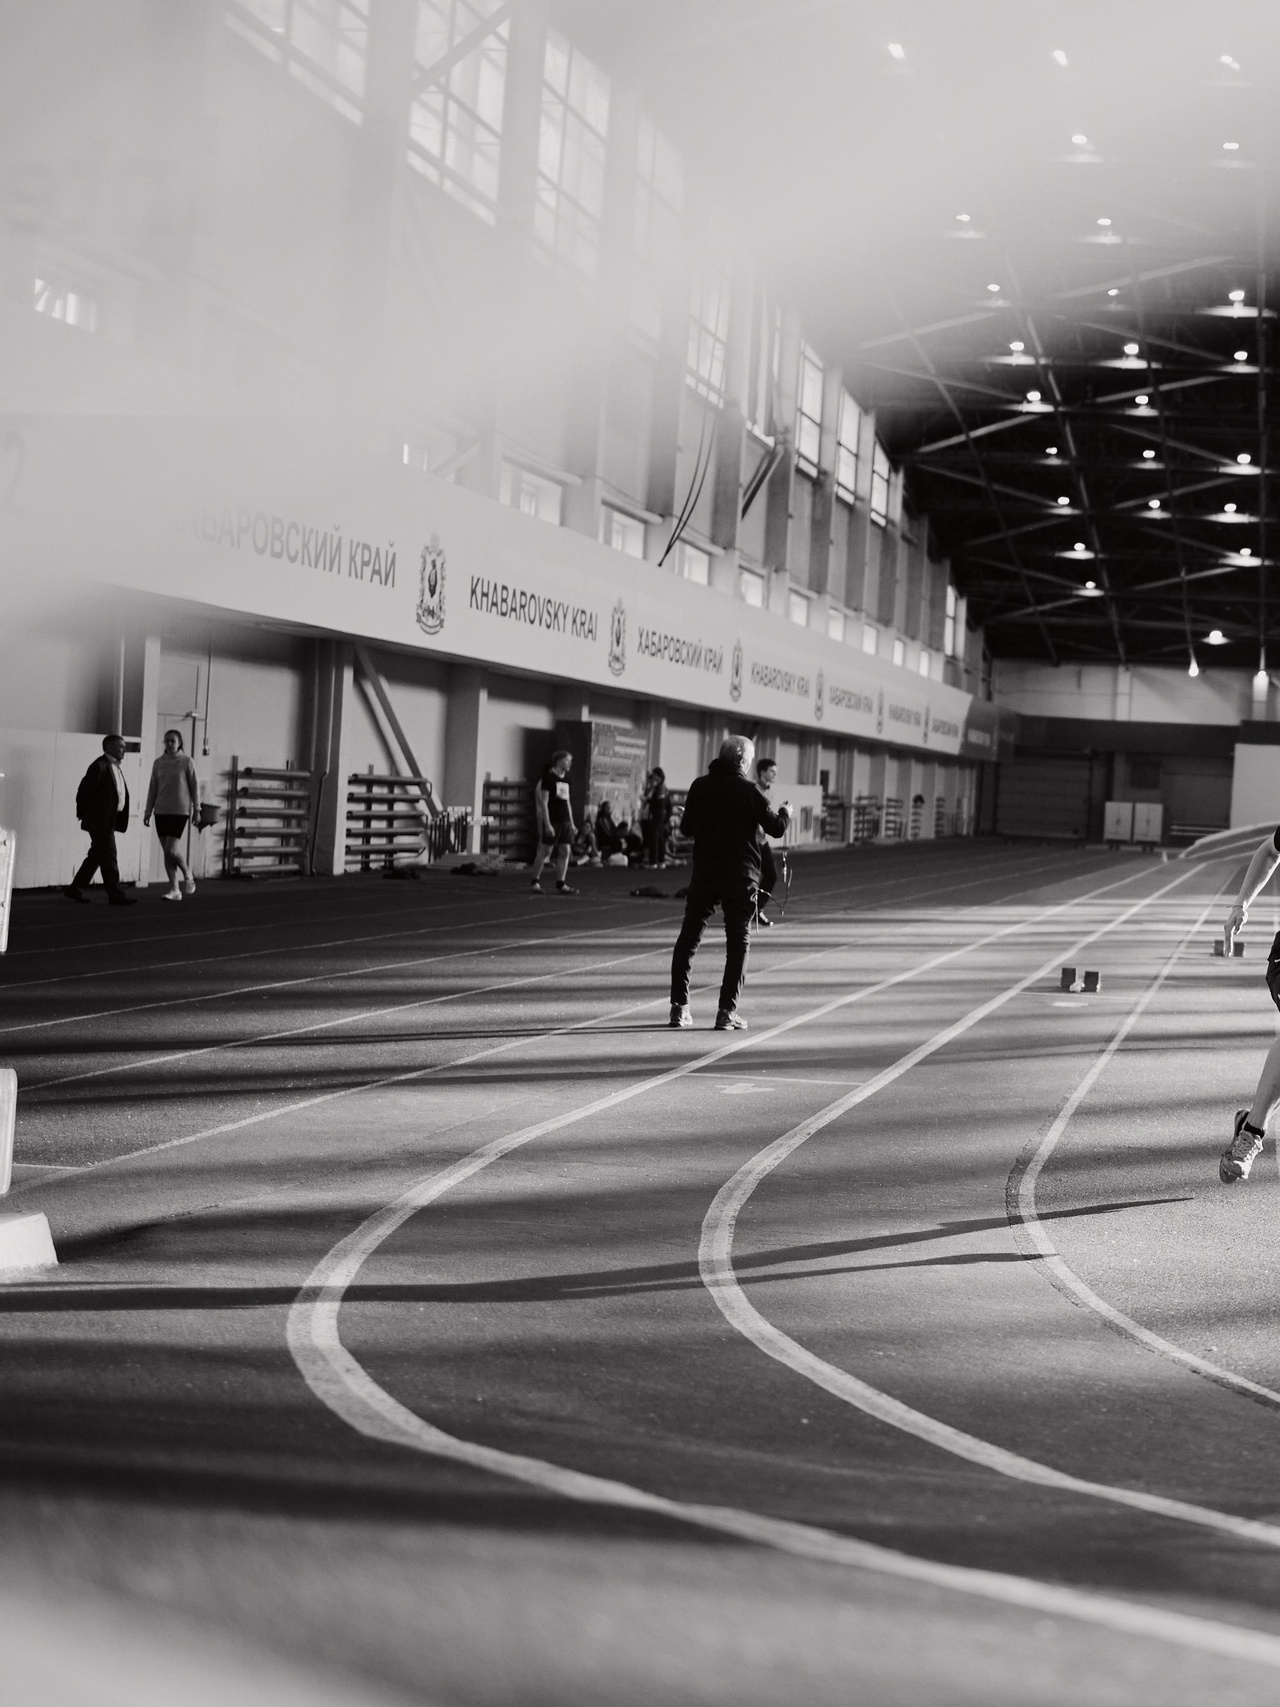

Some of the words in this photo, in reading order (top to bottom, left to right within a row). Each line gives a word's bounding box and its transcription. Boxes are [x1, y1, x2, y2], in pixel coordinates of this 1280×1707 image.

[176, 505, 342, 575] БАРОВСКИЙ
[348, 540, 396, 589] КРАЙ
[470, 575, 569, 634] KHABAROVSKY
[571, 606, 598, 642] KRAI
[637, 626, 702, 670] ХАБАРОВСКИЙ
[703, 644, 724, 674] КРАЙ
